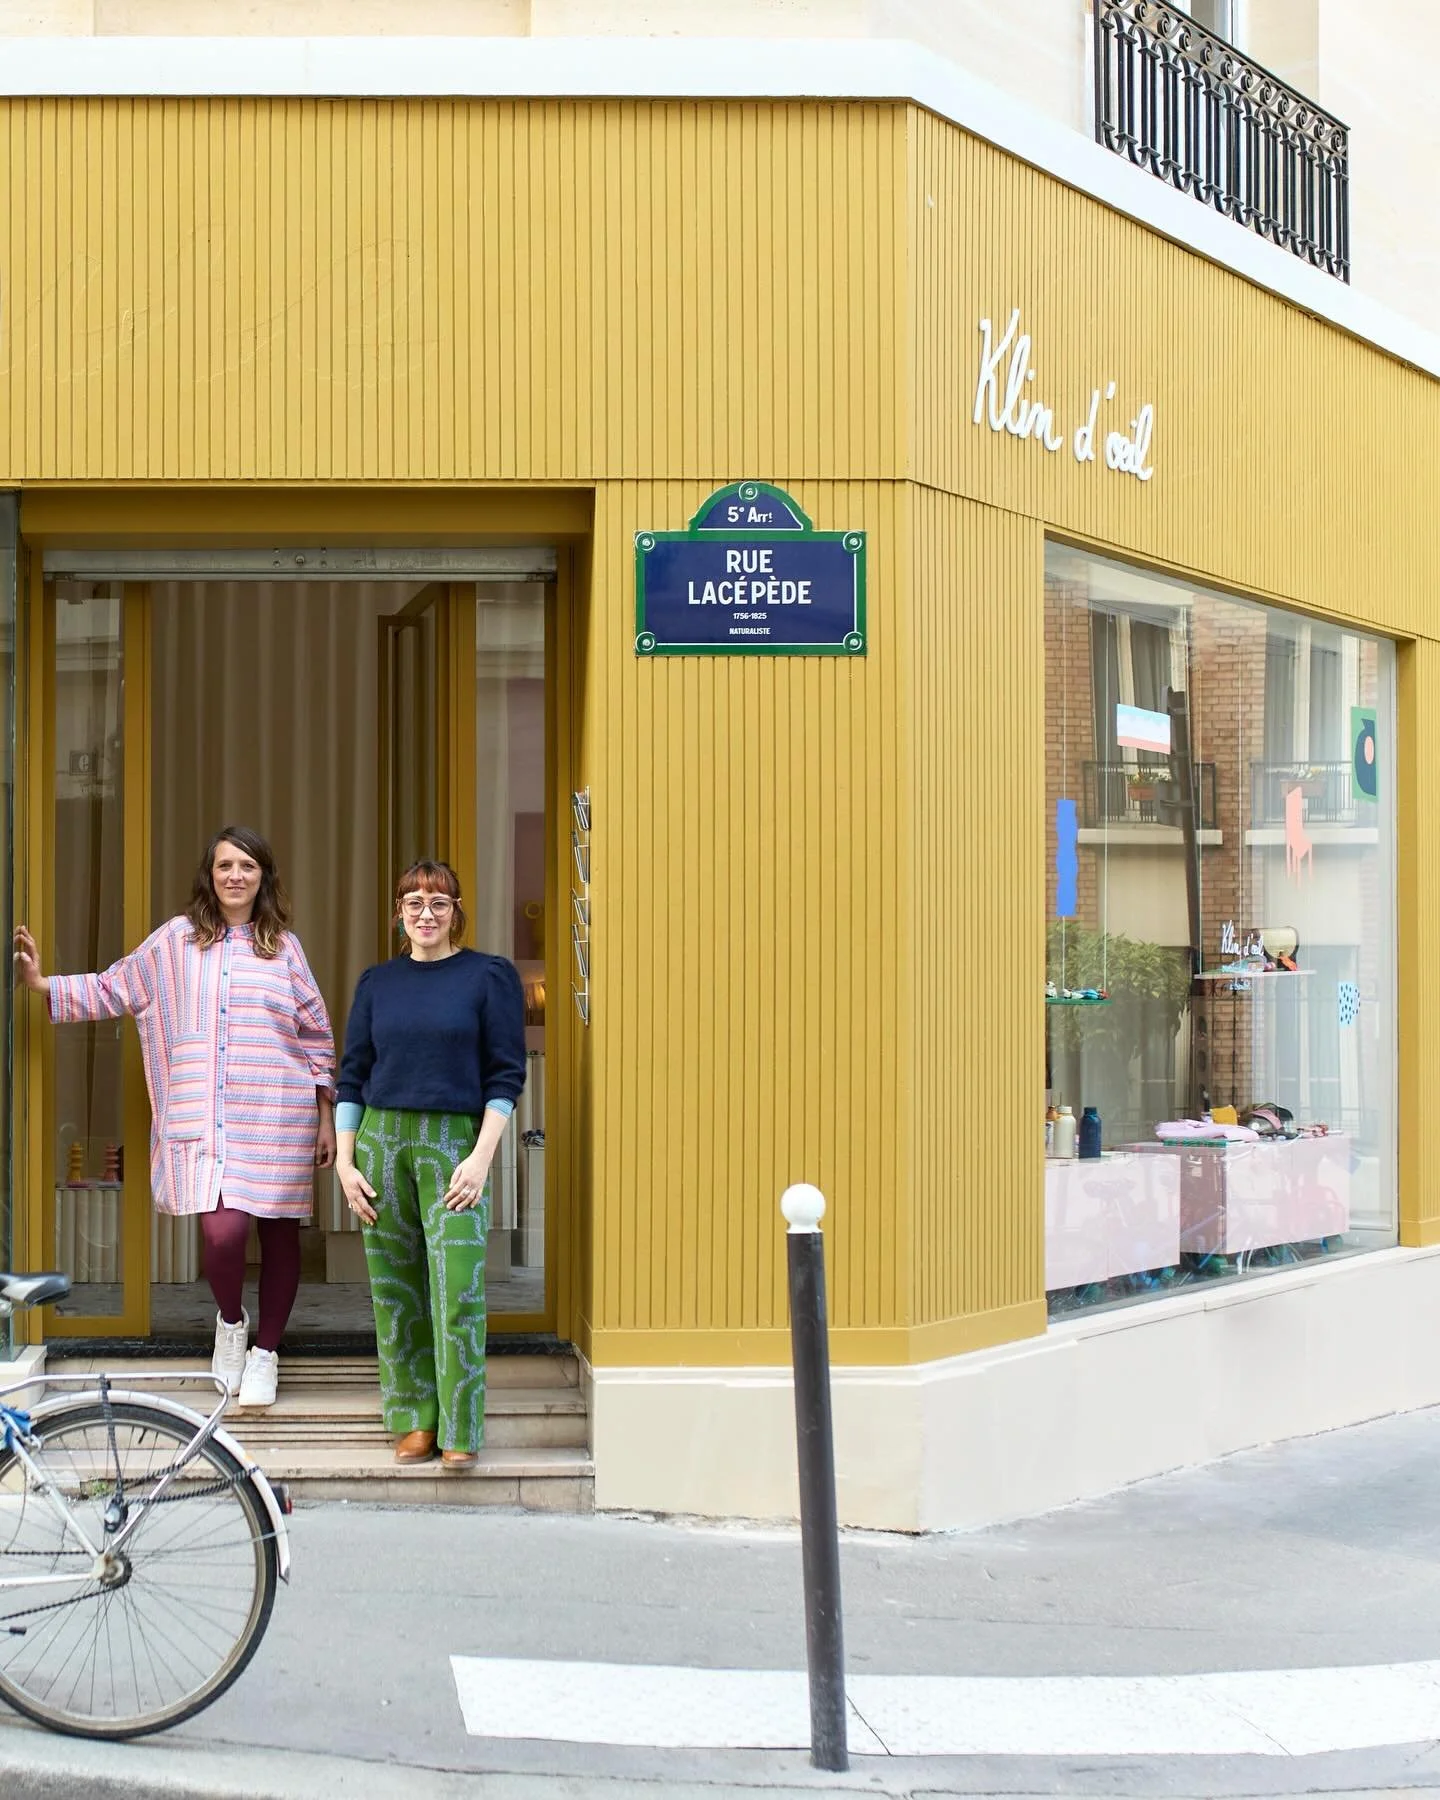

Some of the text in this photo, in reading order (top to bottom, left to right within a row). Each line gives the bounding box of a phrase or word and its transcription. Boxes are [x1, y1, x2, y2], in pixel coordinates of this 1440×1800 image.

[726, 549, 774, 573] RUE
[688, 576, 812, 605] LACÉPÈDE
[733, 612, 768, 620] 1756-1825
[729, 627, 771, 635] NATURALISTE
